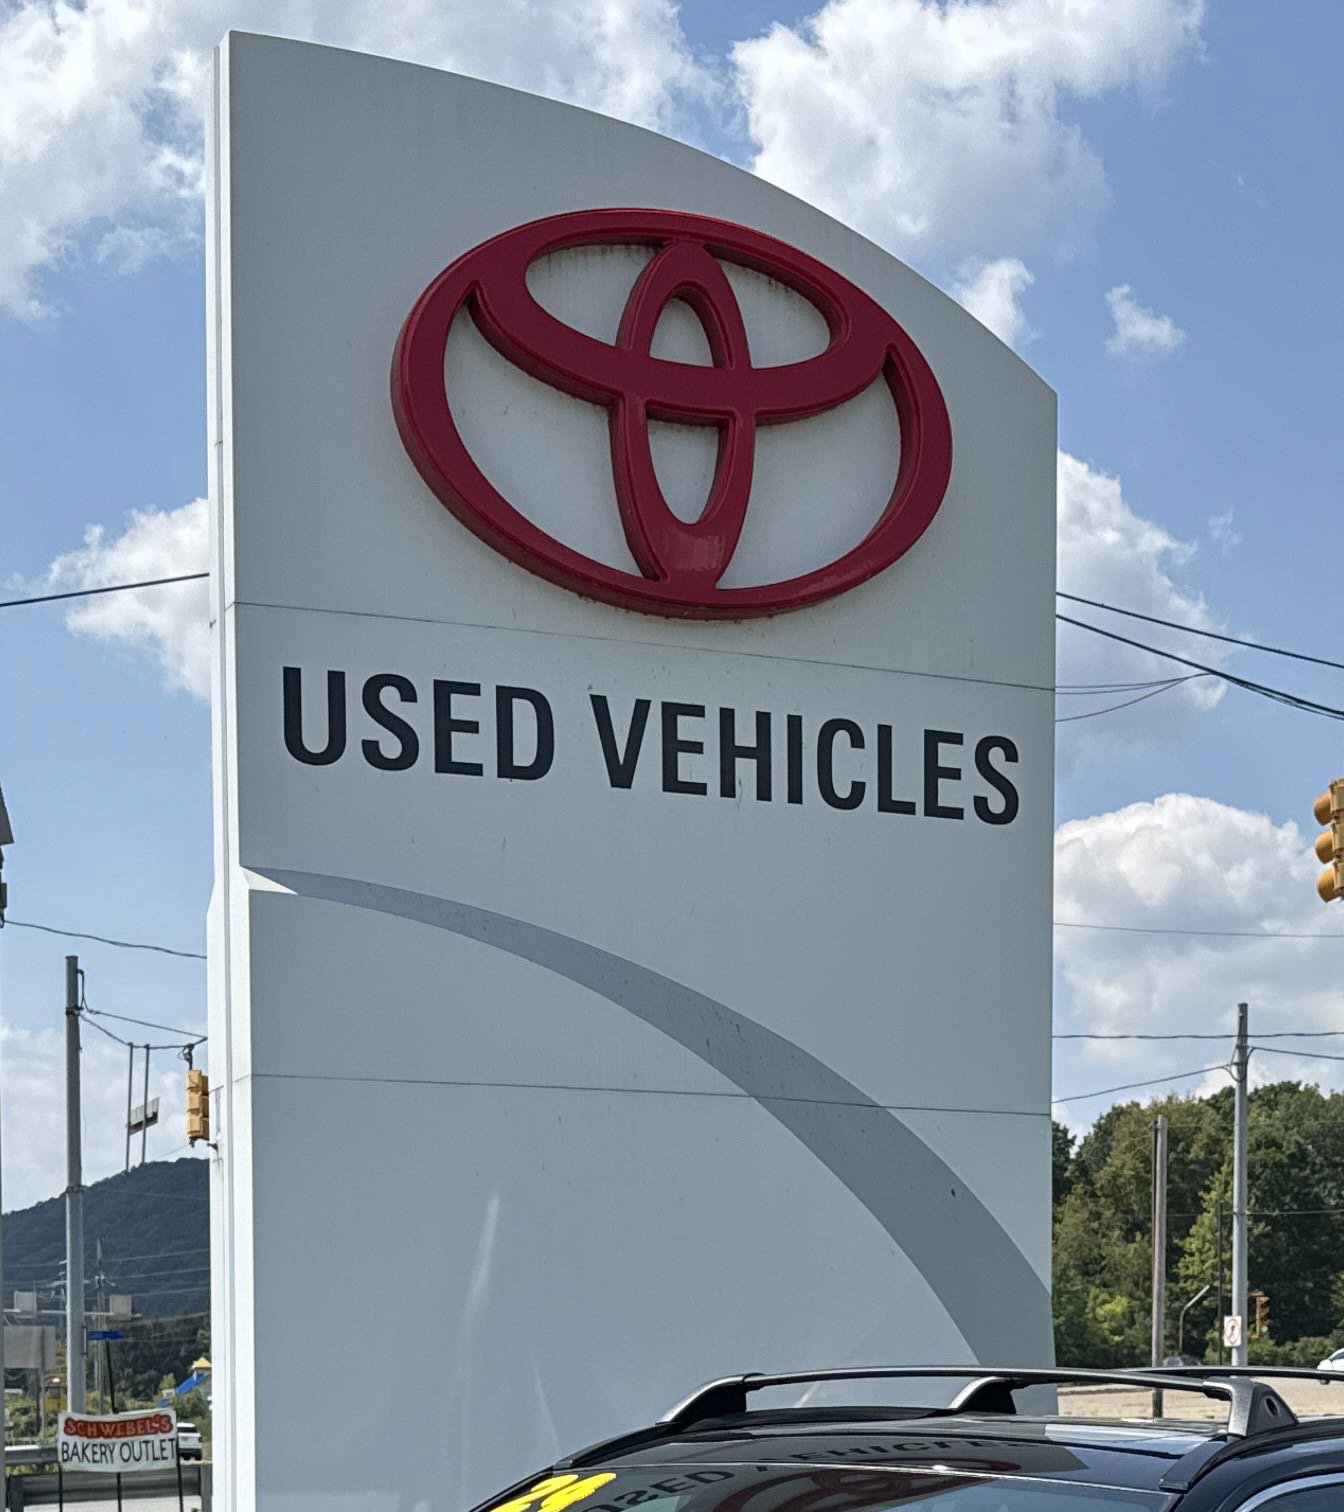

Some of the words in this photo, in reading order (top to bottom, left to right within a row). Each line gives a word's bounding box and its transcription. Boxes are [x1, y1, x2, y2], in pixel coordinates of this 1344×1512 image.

[281, 666, 556, 781] USED
[589, 694, 1020, 825] VEHICLES
[64, 1414, 173, 1438] SCHWEBEL'S
[61, 1440, 116, 1464] BAKERY
[119, 1438, 175, 1463] OUTLET
